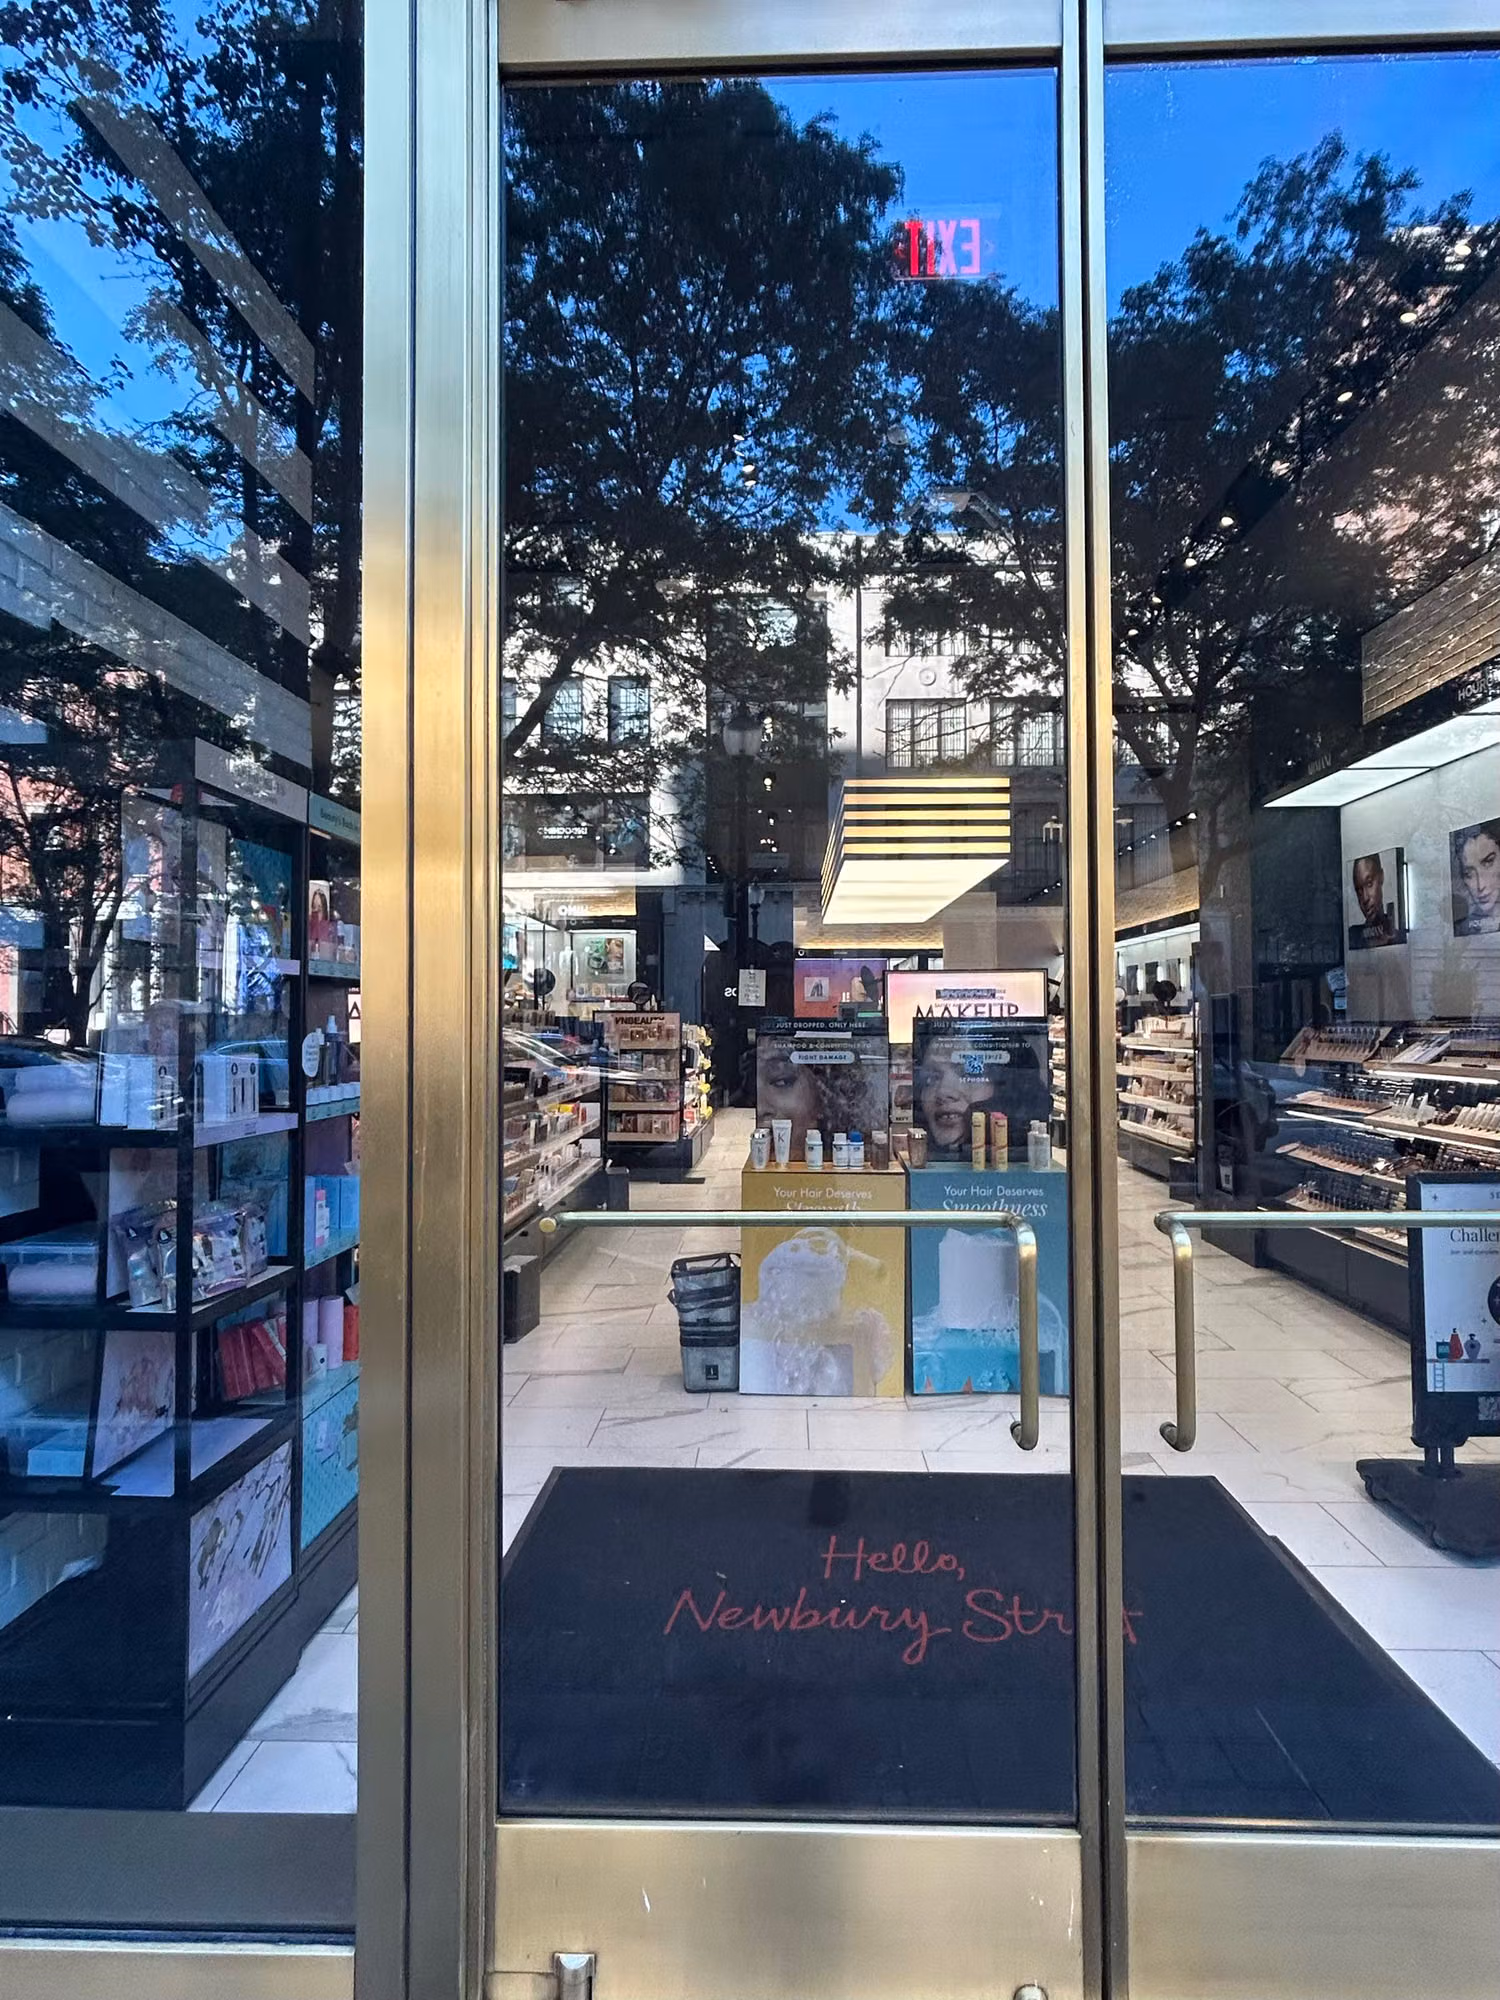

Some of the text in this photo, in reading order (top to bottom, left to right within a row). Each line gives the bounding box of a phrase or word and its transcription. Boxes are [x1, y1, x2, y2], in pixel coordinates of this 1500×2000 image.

[1458, 673, 1499, 702] HOURG
[773, 1186, 873, 1199] Your Hair Deserves
[943, 1185, 1045, 1197] Your Hair Deserves
[821, 1535, 966, 1581] Hello,
[664, 1587, 1144, 1665] Newbury Strt
